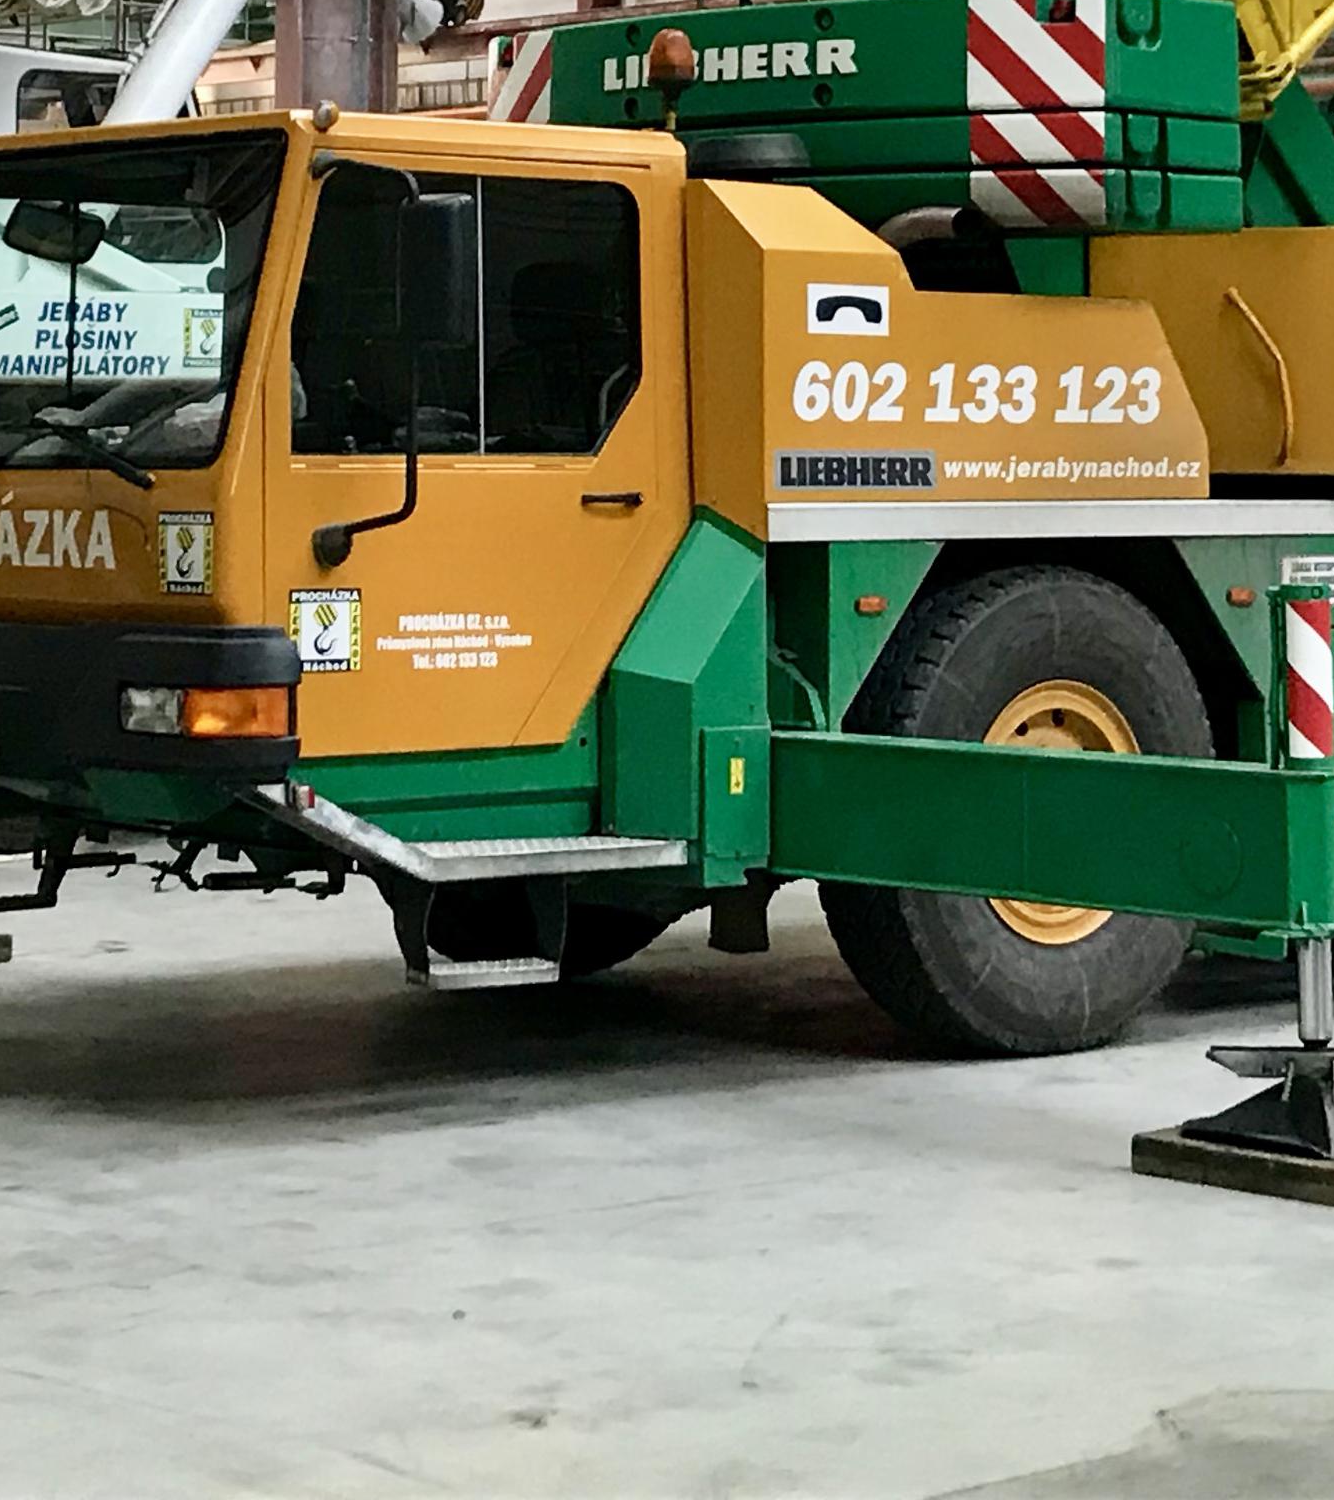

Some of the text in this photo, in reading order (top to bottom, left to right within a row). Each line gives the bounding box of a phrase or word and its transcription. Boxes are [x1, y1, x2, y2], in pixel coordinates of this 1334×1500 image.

[603, 39, 859, 91] LIHERR
[34, 323, 138, 350] PLOŠINY
[792, 360, 1163, 425] 602 133 123
[779, 455, 1202, 488] LIEBHERR www.jerabynachod.cz
[291, 588, 360, 602] PROCHÁZKA
[398, 611, 465, 631] PROCHÁZKA
[302, 660, 348, 672] Náchod
